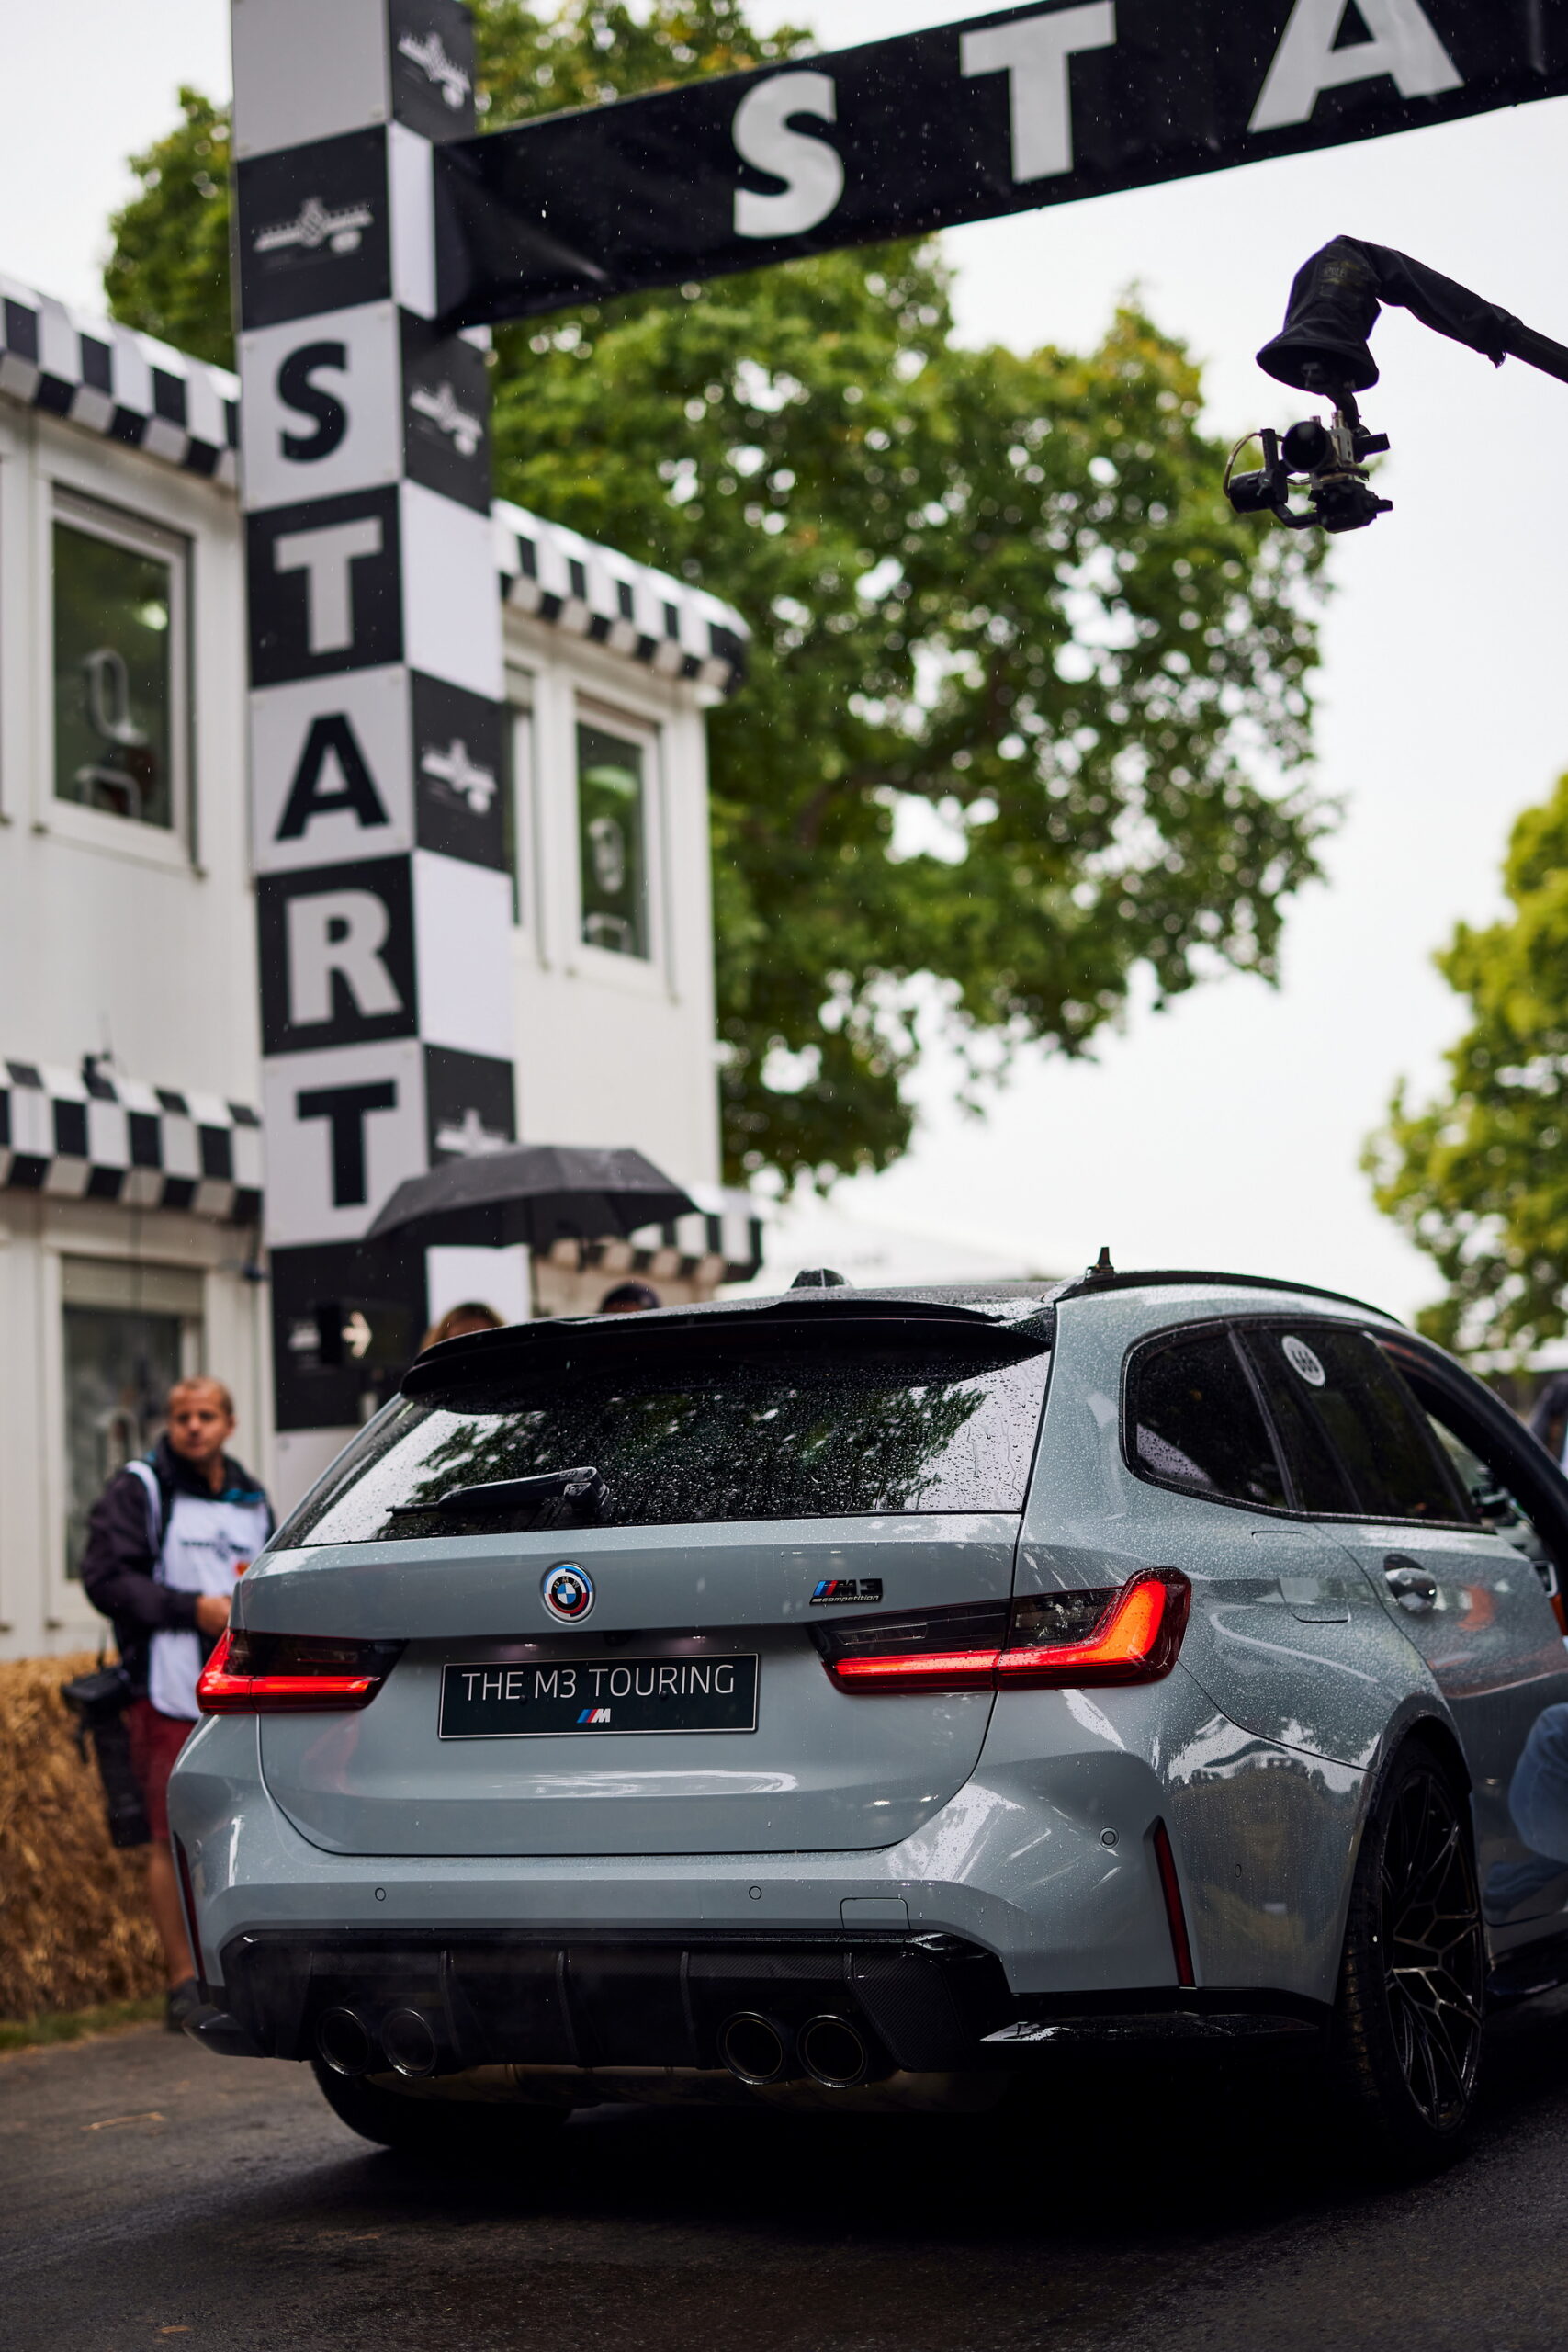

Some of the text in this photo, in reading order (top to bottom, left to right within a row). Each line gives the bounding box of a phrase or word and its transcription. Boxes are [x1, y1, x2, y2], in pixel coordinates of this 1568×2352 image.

[272, 340, 404, 1209] START
[821, 1594, 880, 1603] competition
[461, 1664, 734, 1701] THE M3 TOURING
